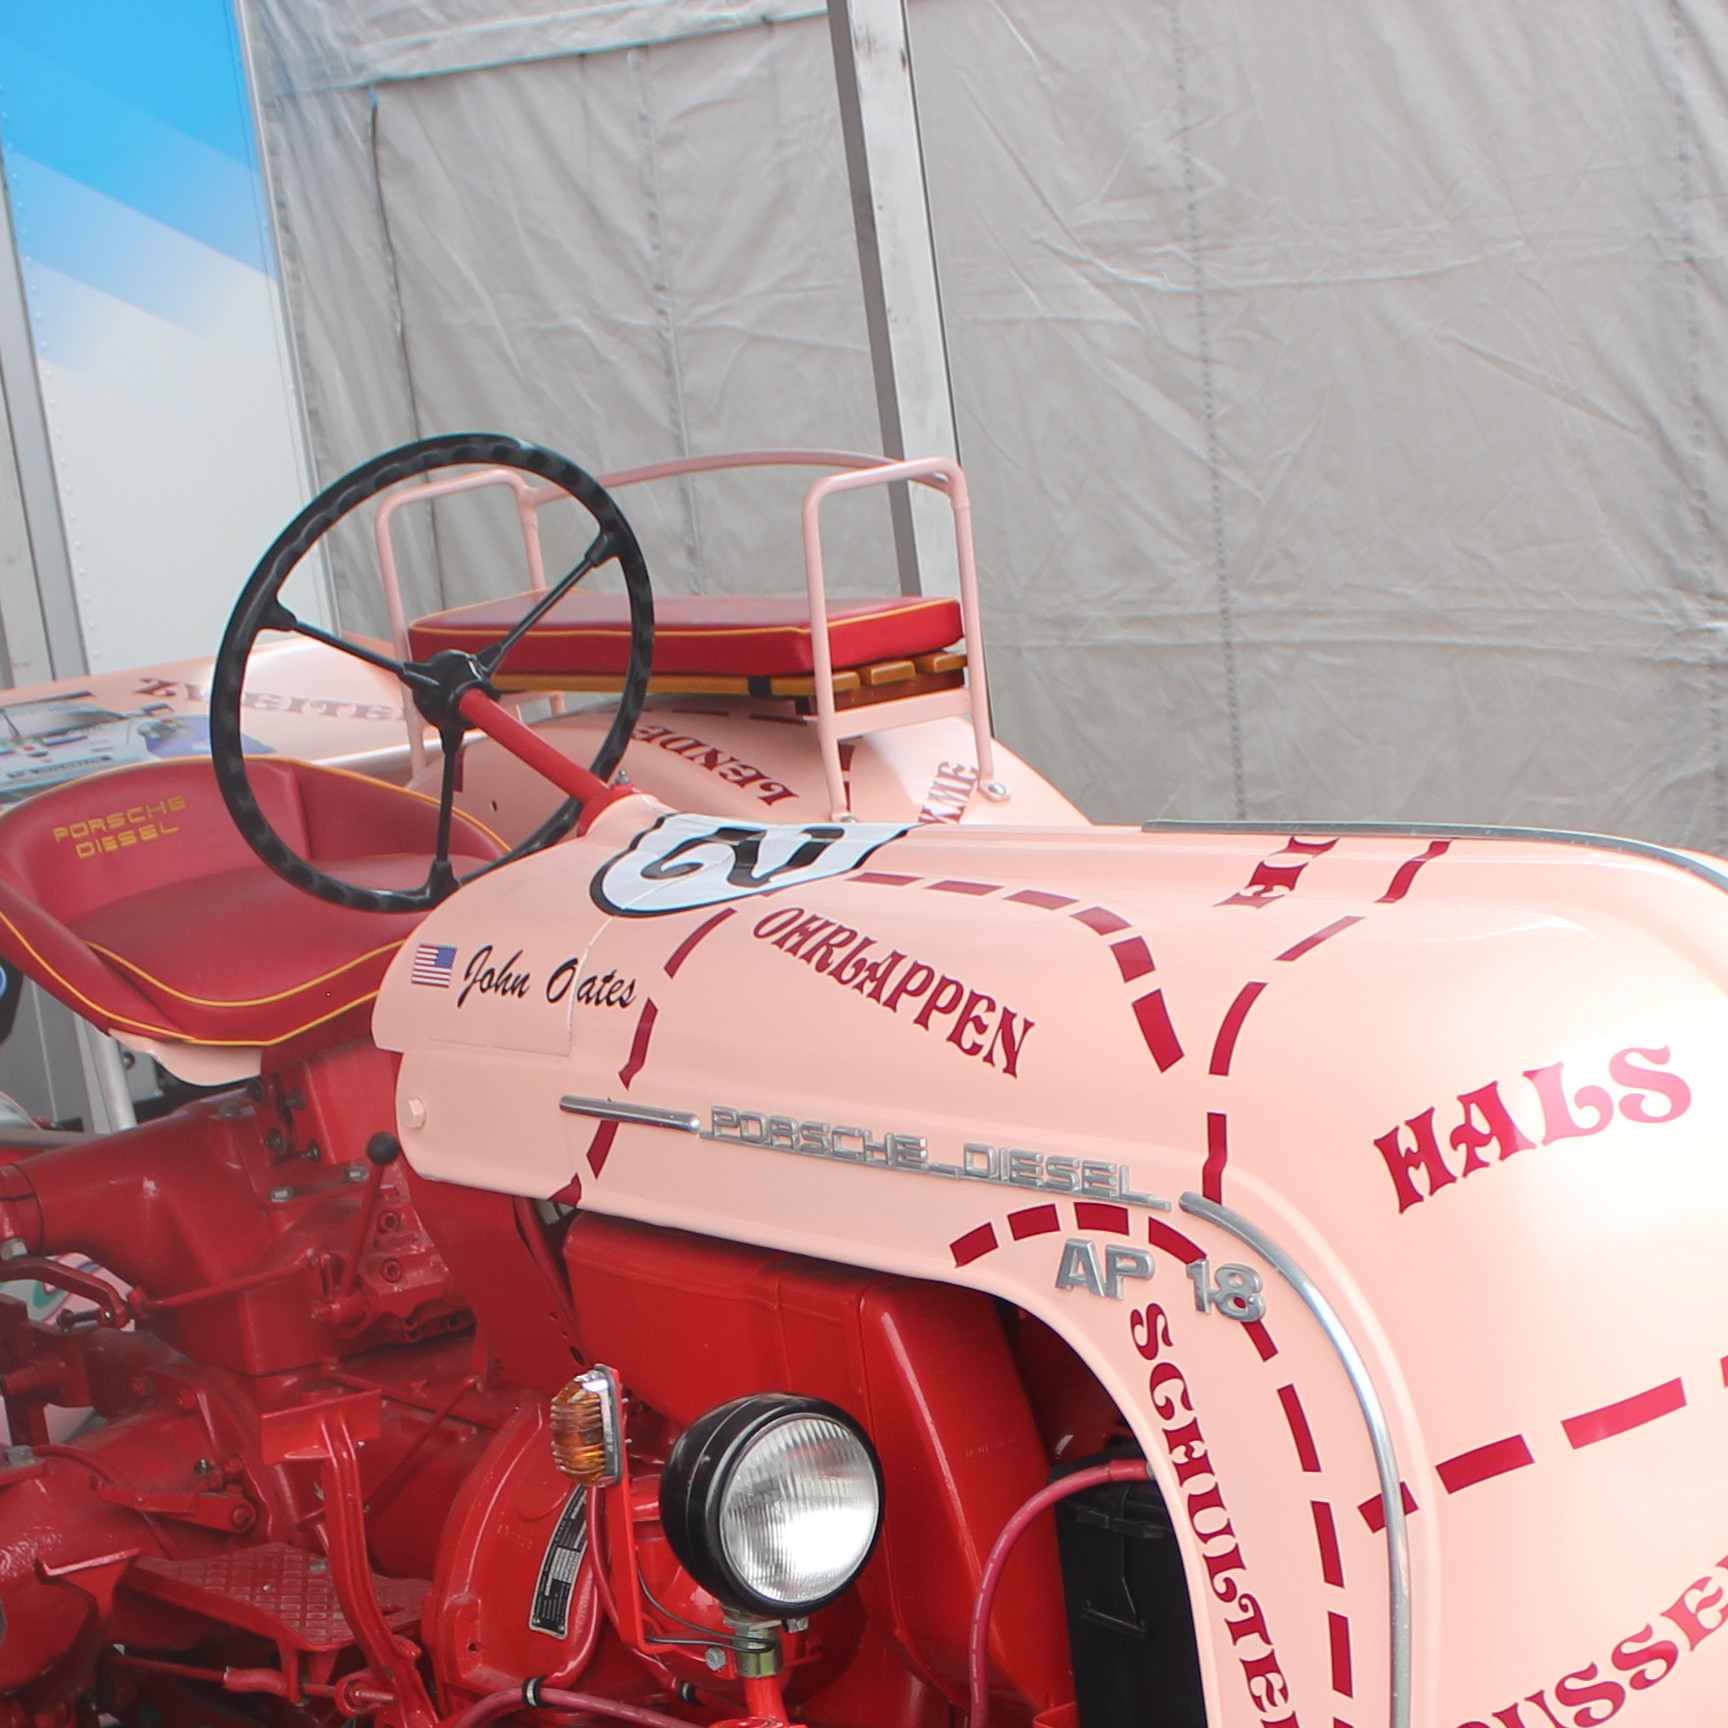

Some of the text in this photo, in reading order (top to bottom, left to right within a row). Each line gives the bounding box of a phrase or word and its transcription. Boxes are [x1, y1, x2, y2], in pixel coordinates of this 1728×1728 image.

[52, 795, 188, 842] PORSCHE
[75, 823, 181, 859] DIESEL
[457, 945, 530, 1008] John
[753, 907, 1034, 1078] OHRLAPPEN
[710, 1105, 1156, 1203] PORSCHE DIESEL
[1373, 1045, 1692, 1214] HALS
[1055, 1239, 1267, 1323] AP 18
